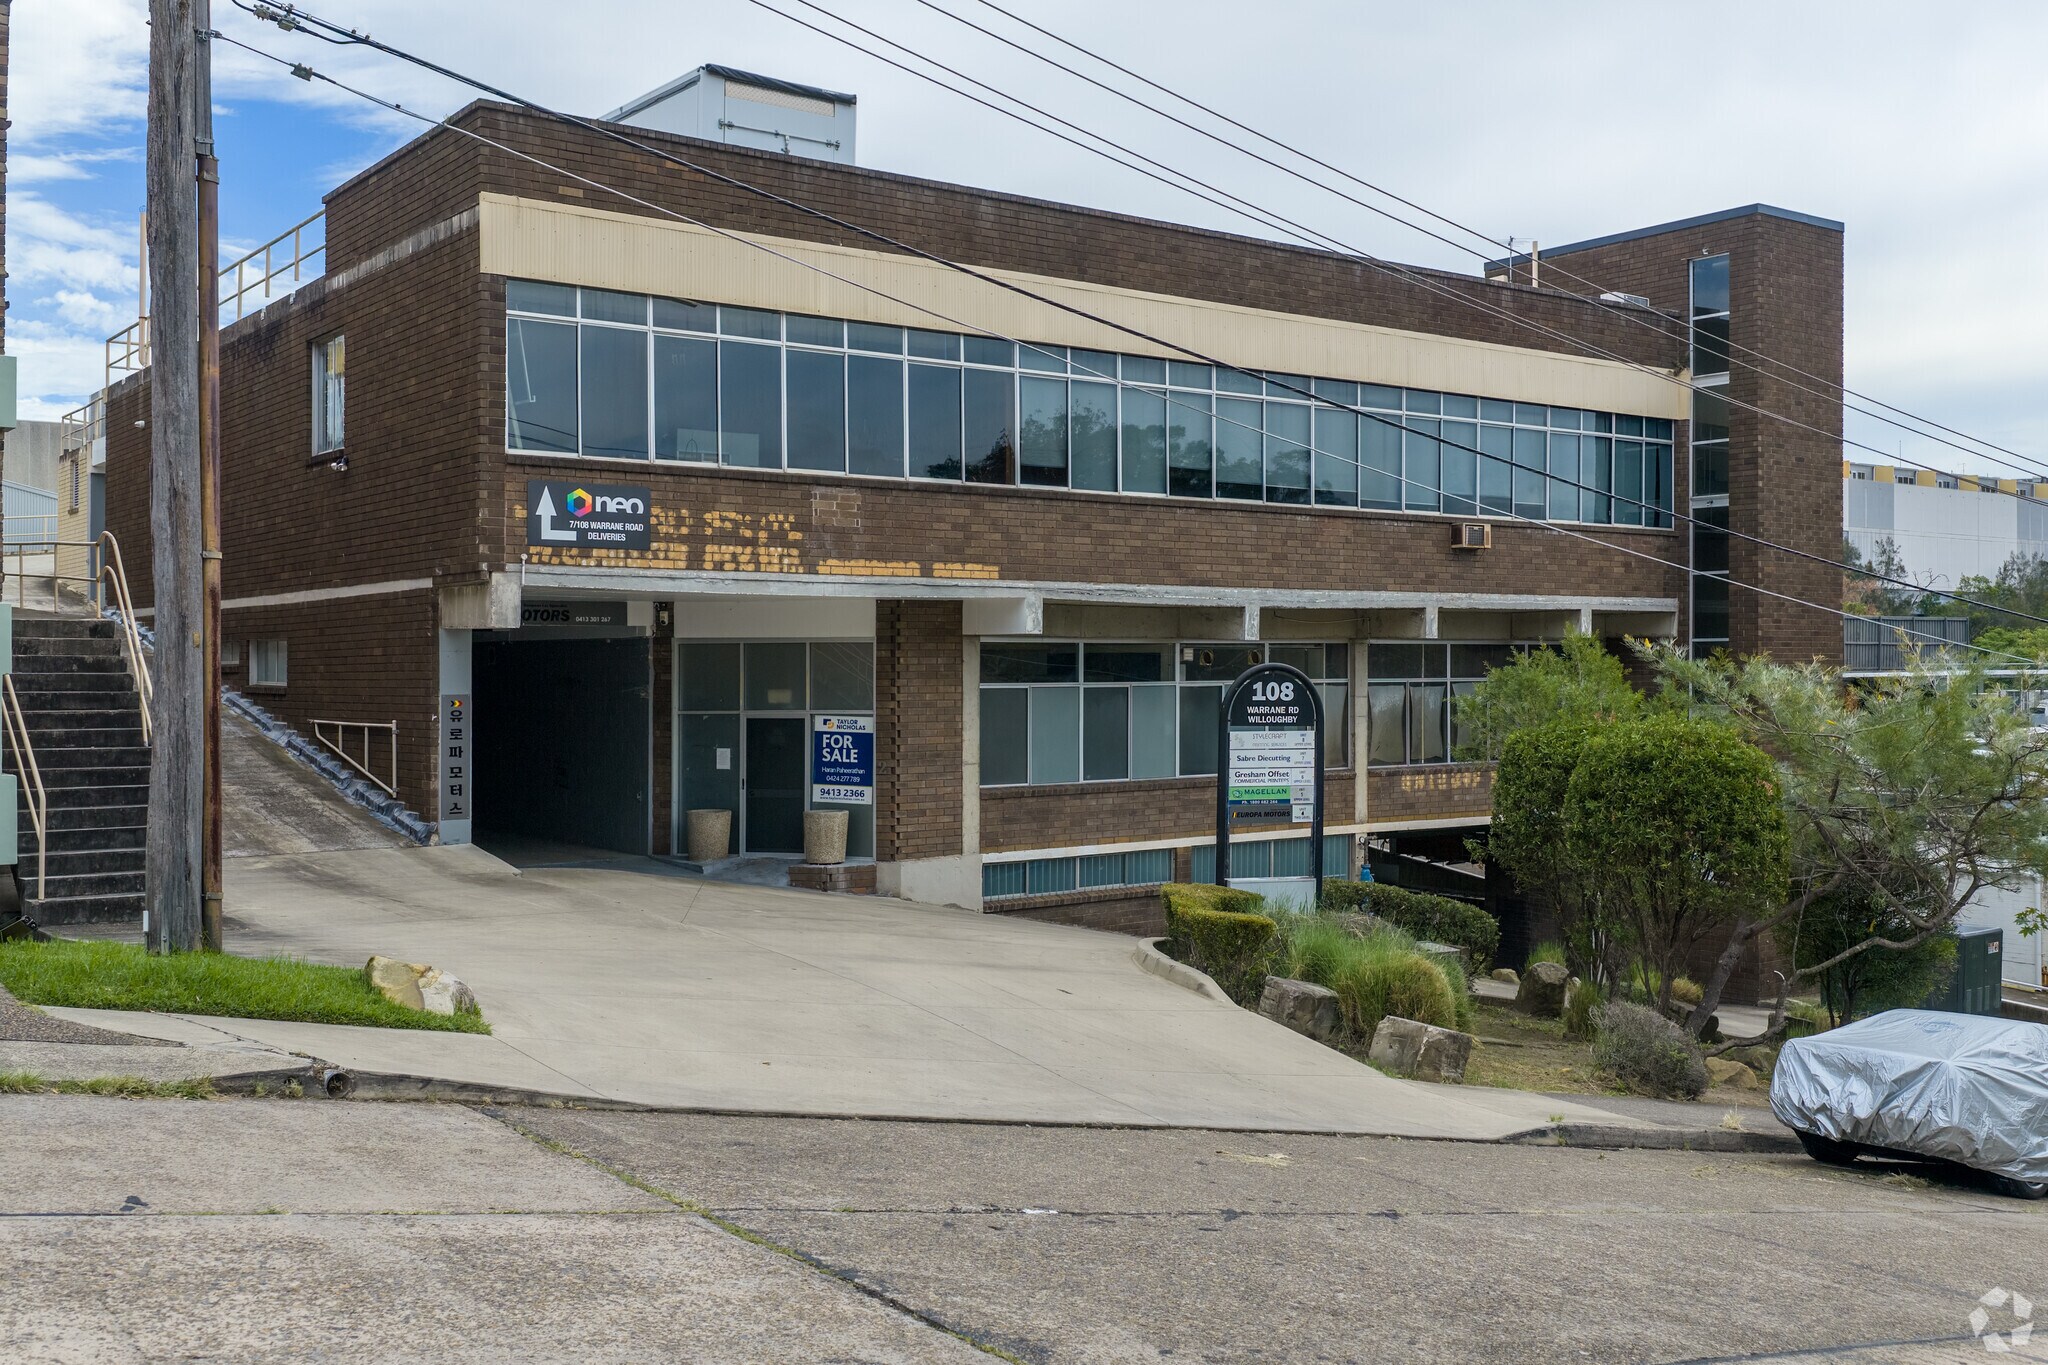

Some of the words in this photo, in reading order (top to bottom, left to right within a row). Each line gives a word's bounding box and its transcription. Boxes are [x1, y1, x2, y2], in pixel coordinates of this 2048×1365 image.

[595, 496, 644, 514] neo
[569, 520, 589, 528] 7/108
[590, 521, 624, 531] WARRANE
[625, 523, 644, 532] ROAD
[587, 532, 626, 541] DELIVERIES
[521, 609, 570, 622] OTORS
[1252, 681, 1294, 701] 108
[1247, 706, 1286, 714] WARRANE
[1288, 706, 1299, 714] RD
[1247, 715, 1298, 723] WILLOUGHBY
[822, 734, 853, 749] FOR
[822, 748, 858, 763] SALE
[1257, 755, 1291, 763] Diecutting
[1267, 770, 1289, 778] Offset
[820, 787, 841, 797] 9413
[843, 789, 865, 798] 2366
